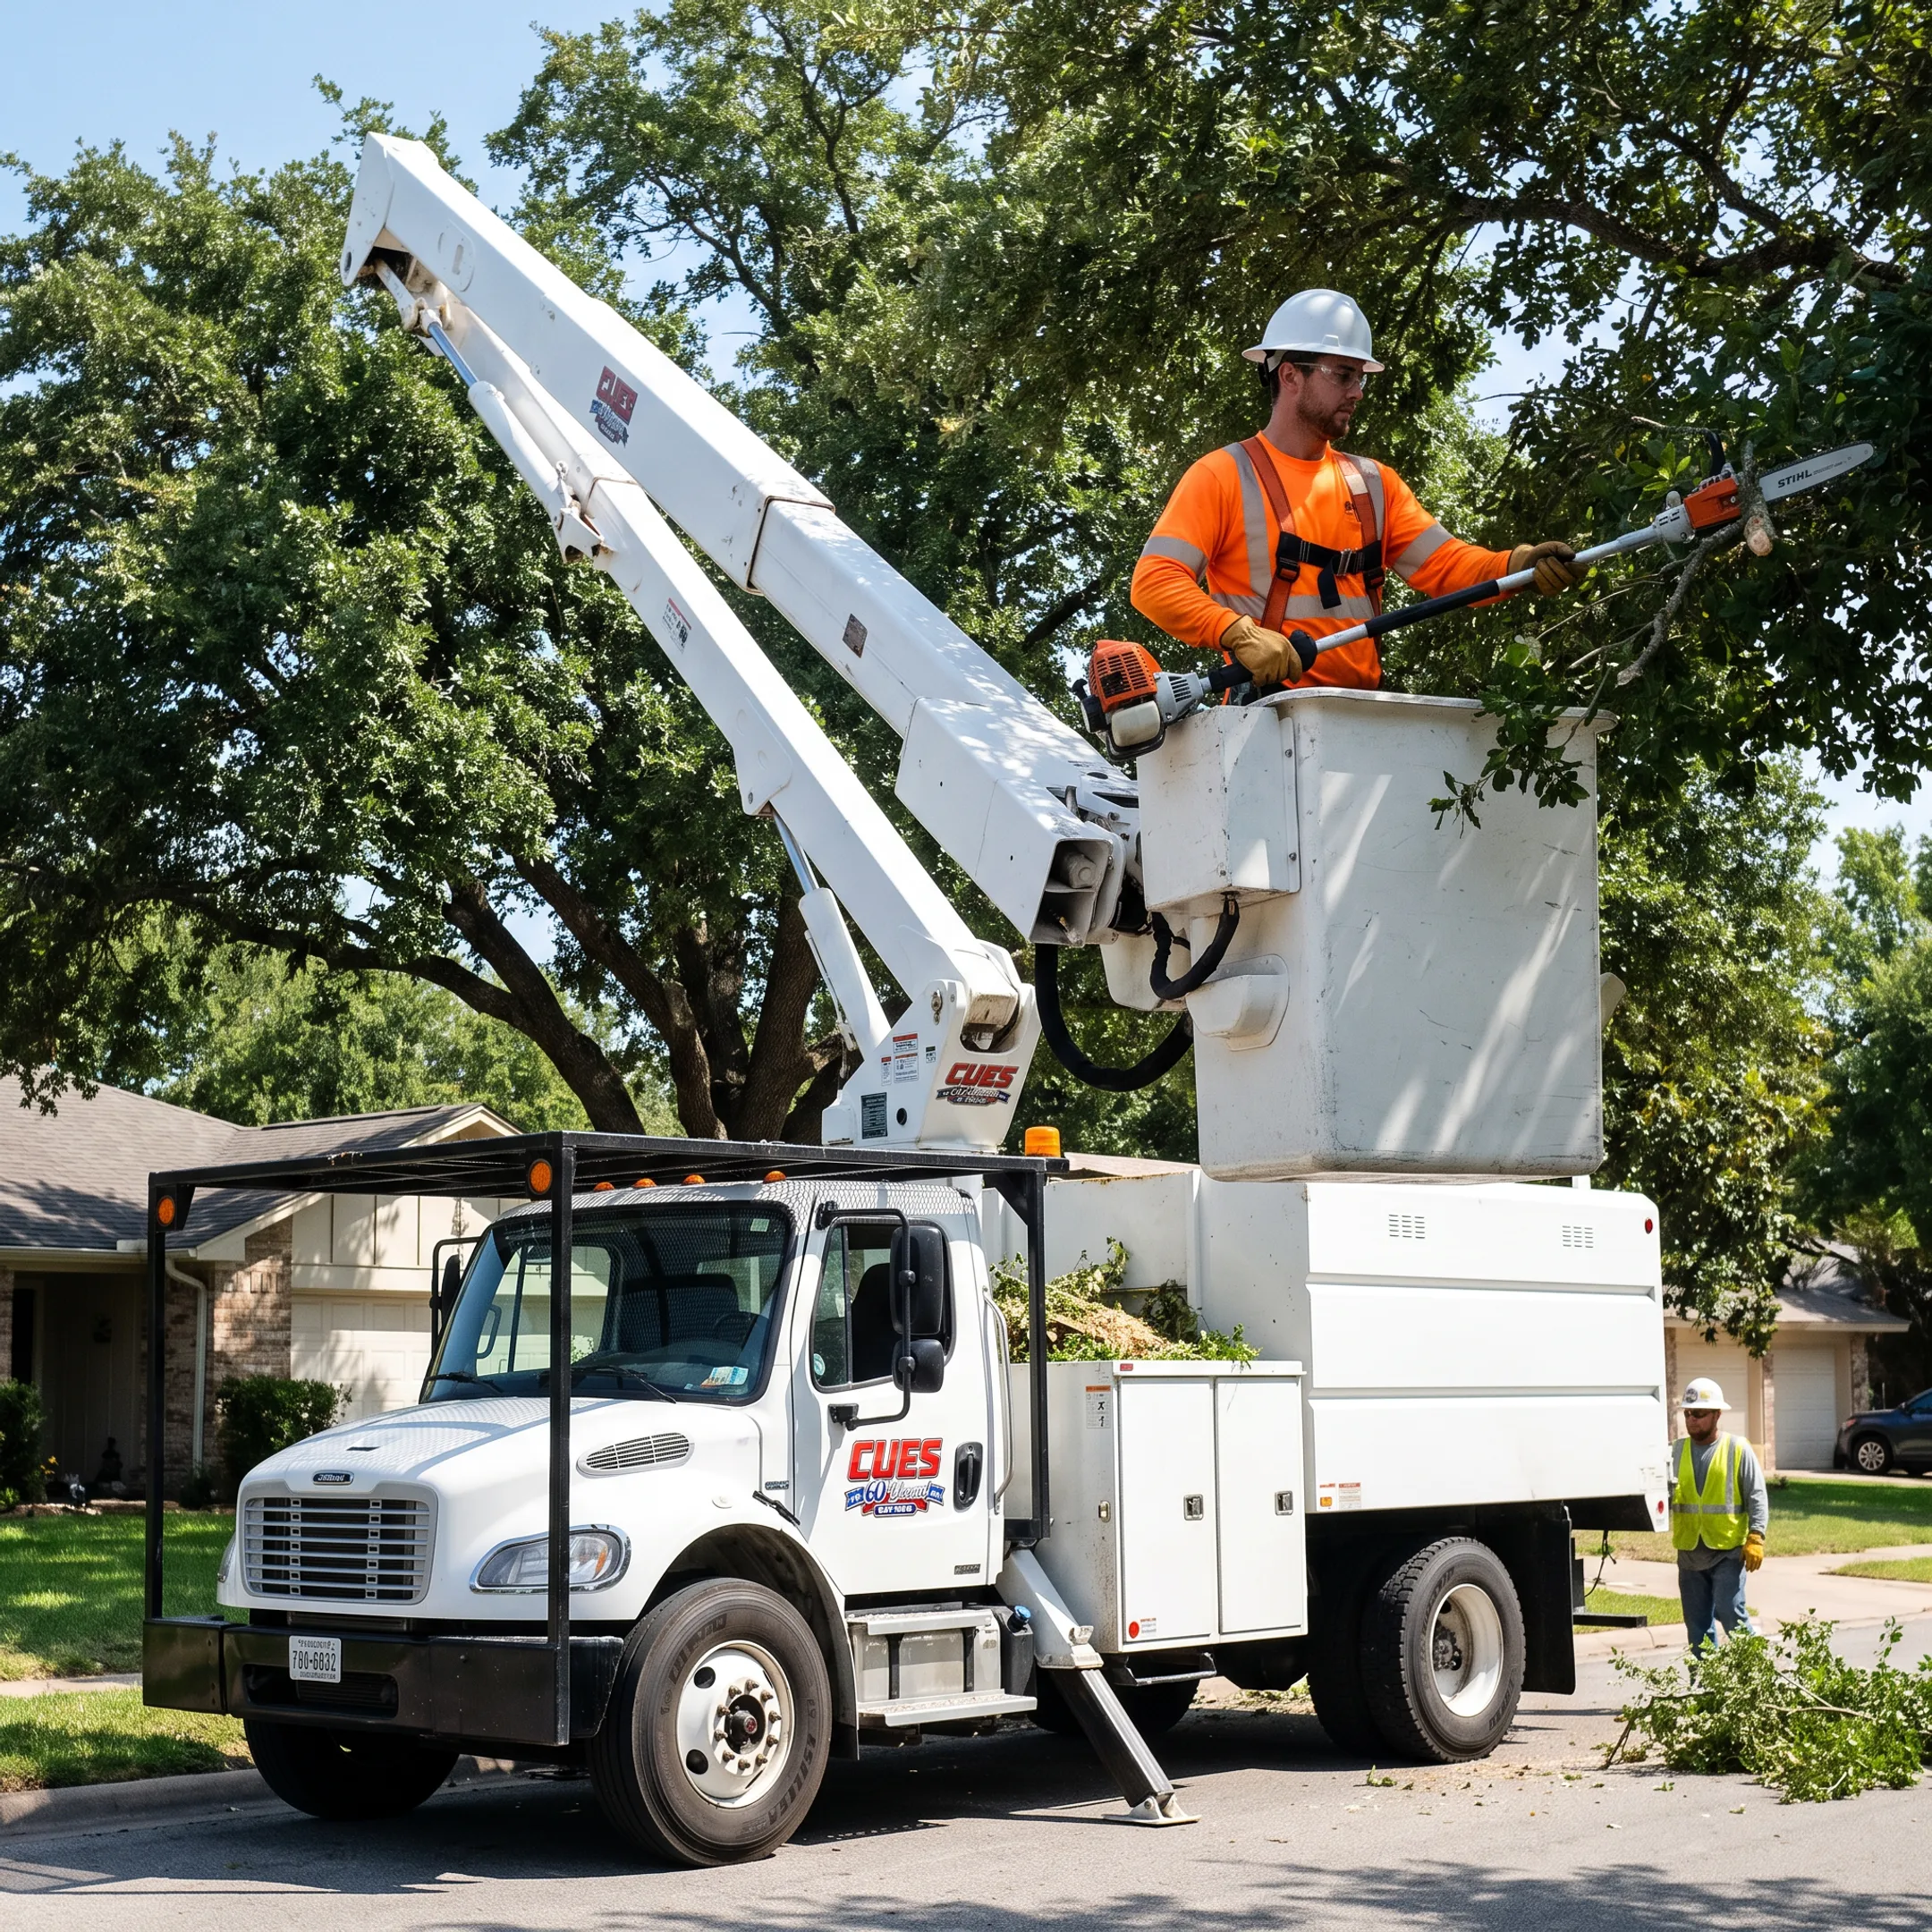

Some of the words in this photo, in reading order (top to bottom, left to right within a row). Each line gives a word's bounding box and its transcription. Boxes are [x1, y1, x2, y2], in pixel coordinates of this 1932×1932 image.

[1777, 469, 1812, 488] STIHL
[945, 1063, 1019, 1089] CUES
[848, 1438, 943, 1481] CUES
